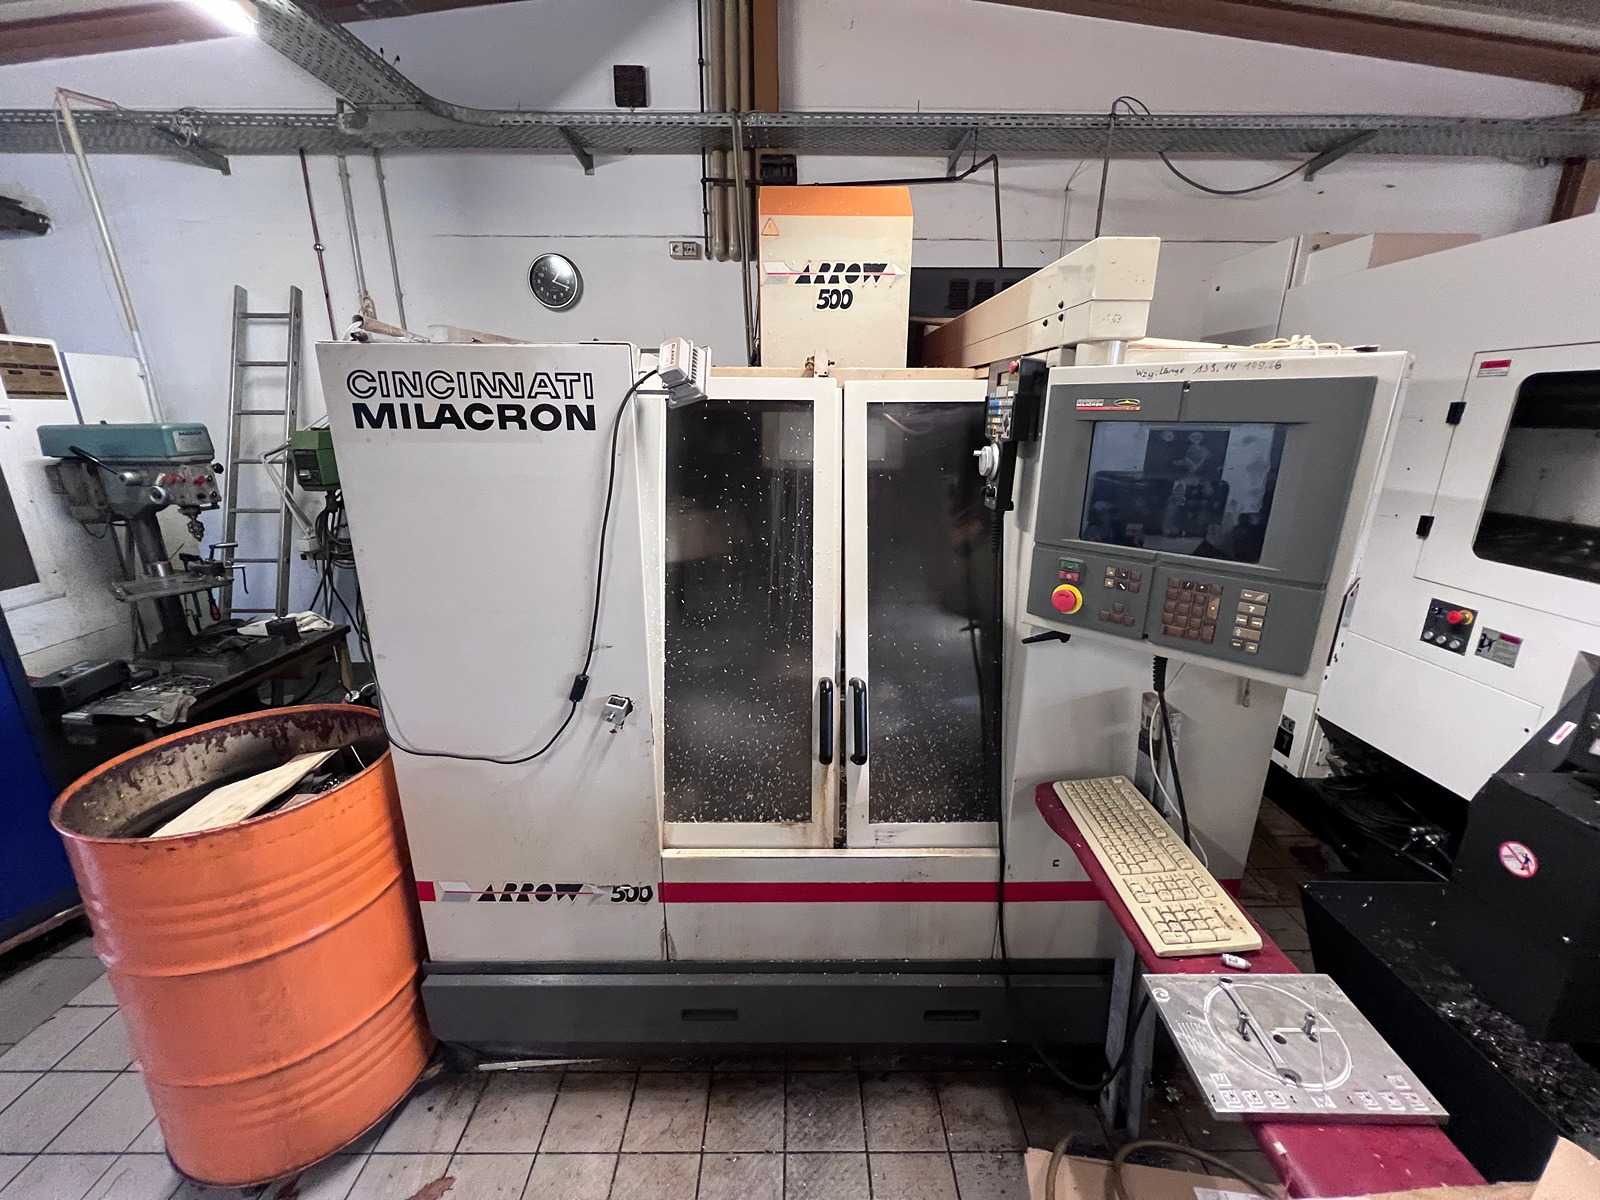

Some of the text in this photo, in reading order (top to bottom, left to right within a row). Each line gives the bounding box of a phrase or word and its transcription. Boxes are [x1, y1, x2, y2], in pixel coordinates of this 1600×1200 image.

[795, 263, 888, 284] ARROW
[816, 289, 853, 310] 500
[347, 370, 594, 399] CINCINNATI
[352, 403, 596, 431] MILACRON
[477, 882, 584, 902] ARROW
[610, 884, 654, 903] 500
